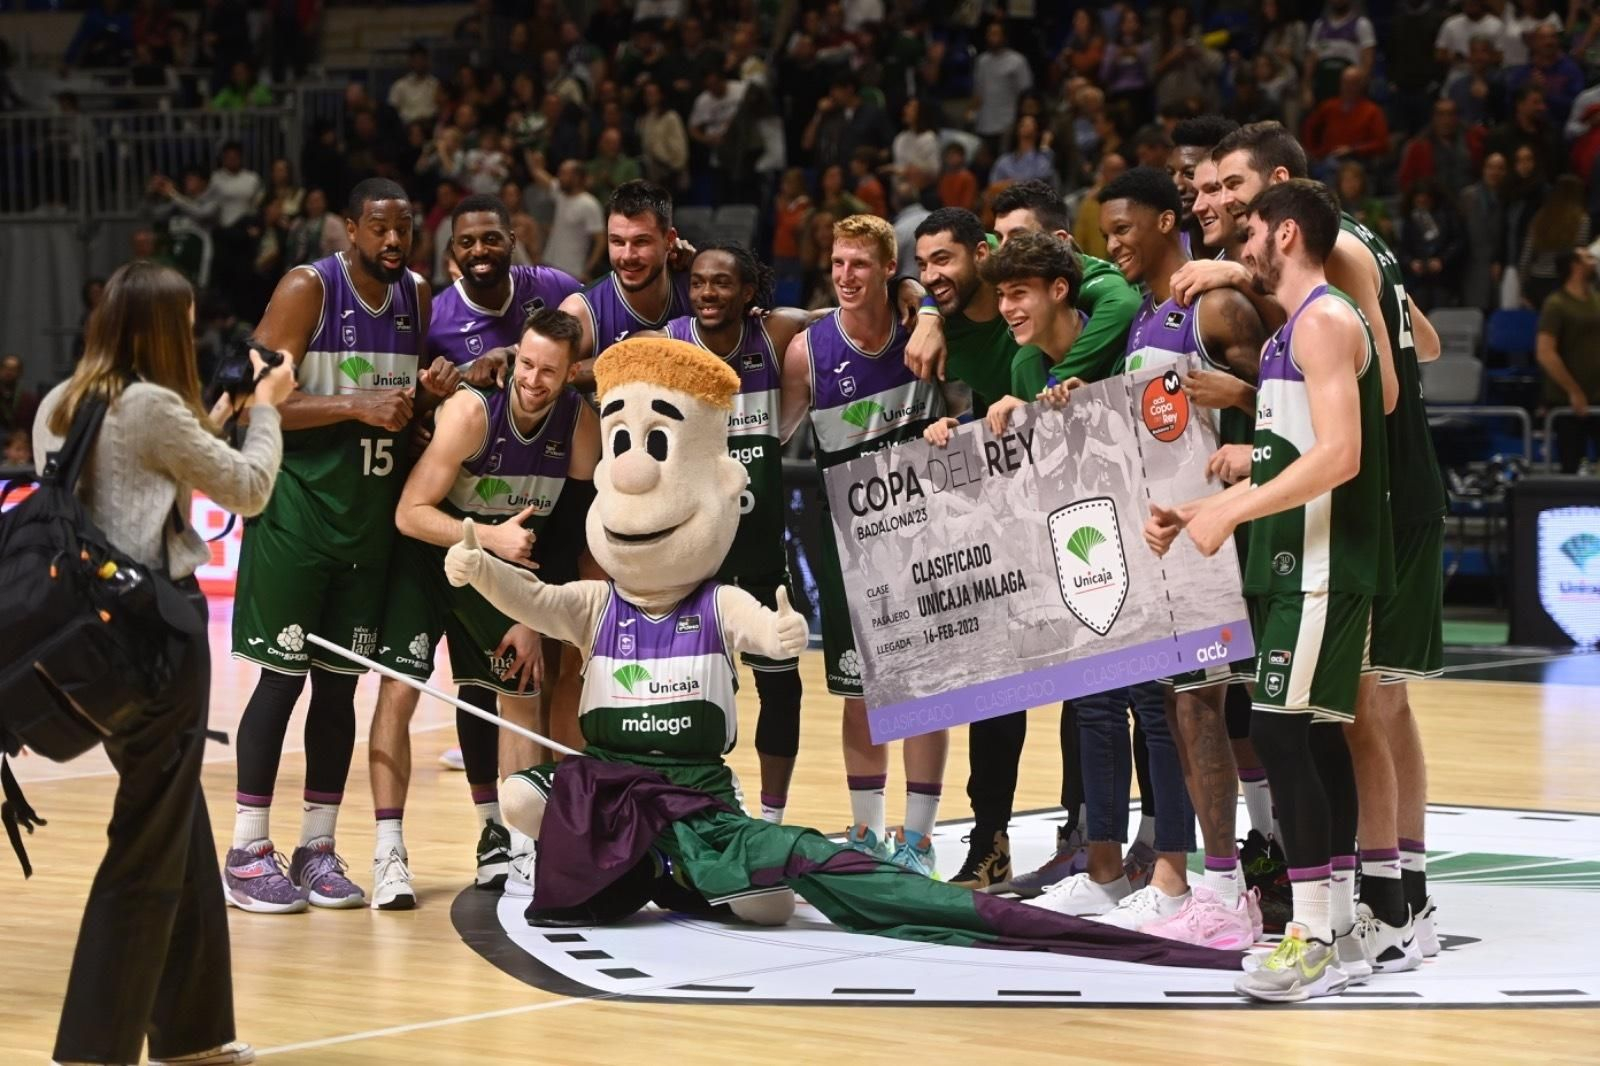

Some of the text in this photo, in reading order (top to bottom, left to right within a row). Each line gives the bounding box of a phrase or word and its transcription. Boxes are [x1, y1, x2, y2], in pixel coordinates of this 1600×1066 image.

[373, 372, 411, 387] Unicaja
[883, 401, 926, 423] Unicaja
[1150, 402, 1173, 416] Copa
[1162, 412, 1178, 424] Rey
[360, 438, 394, 477] 15
[847, 465, 925, 517] COPA
[928, 450, 982, 494] DEL
[984, 428, 1035, 477] REY
[507, 492, 552, 510] Unicaja
[856, 507, 929, 541] BADALONA'23
[912, 542, 993, 585] CLASIFICADO
[1073, 567, 1113, 588] Unicaja
[866, 583, 890, 599] CLASE
[916, 569, 1028, 618] UNICAJA MALAGA
[871, 609, 911, 629] PASAJERO
[923, 616, 980, 645] 16-FEB-2023
[876, 637, 913, 656] LLEGADA
[1196, 642, 1227, 663] acb
[649, 676, 700, 694] Unicaja
[878, 650, 1170, 735] CLASIFICADO CLASIFICADO CLASIFICADO
[622, 712, 692, 735] málaga
